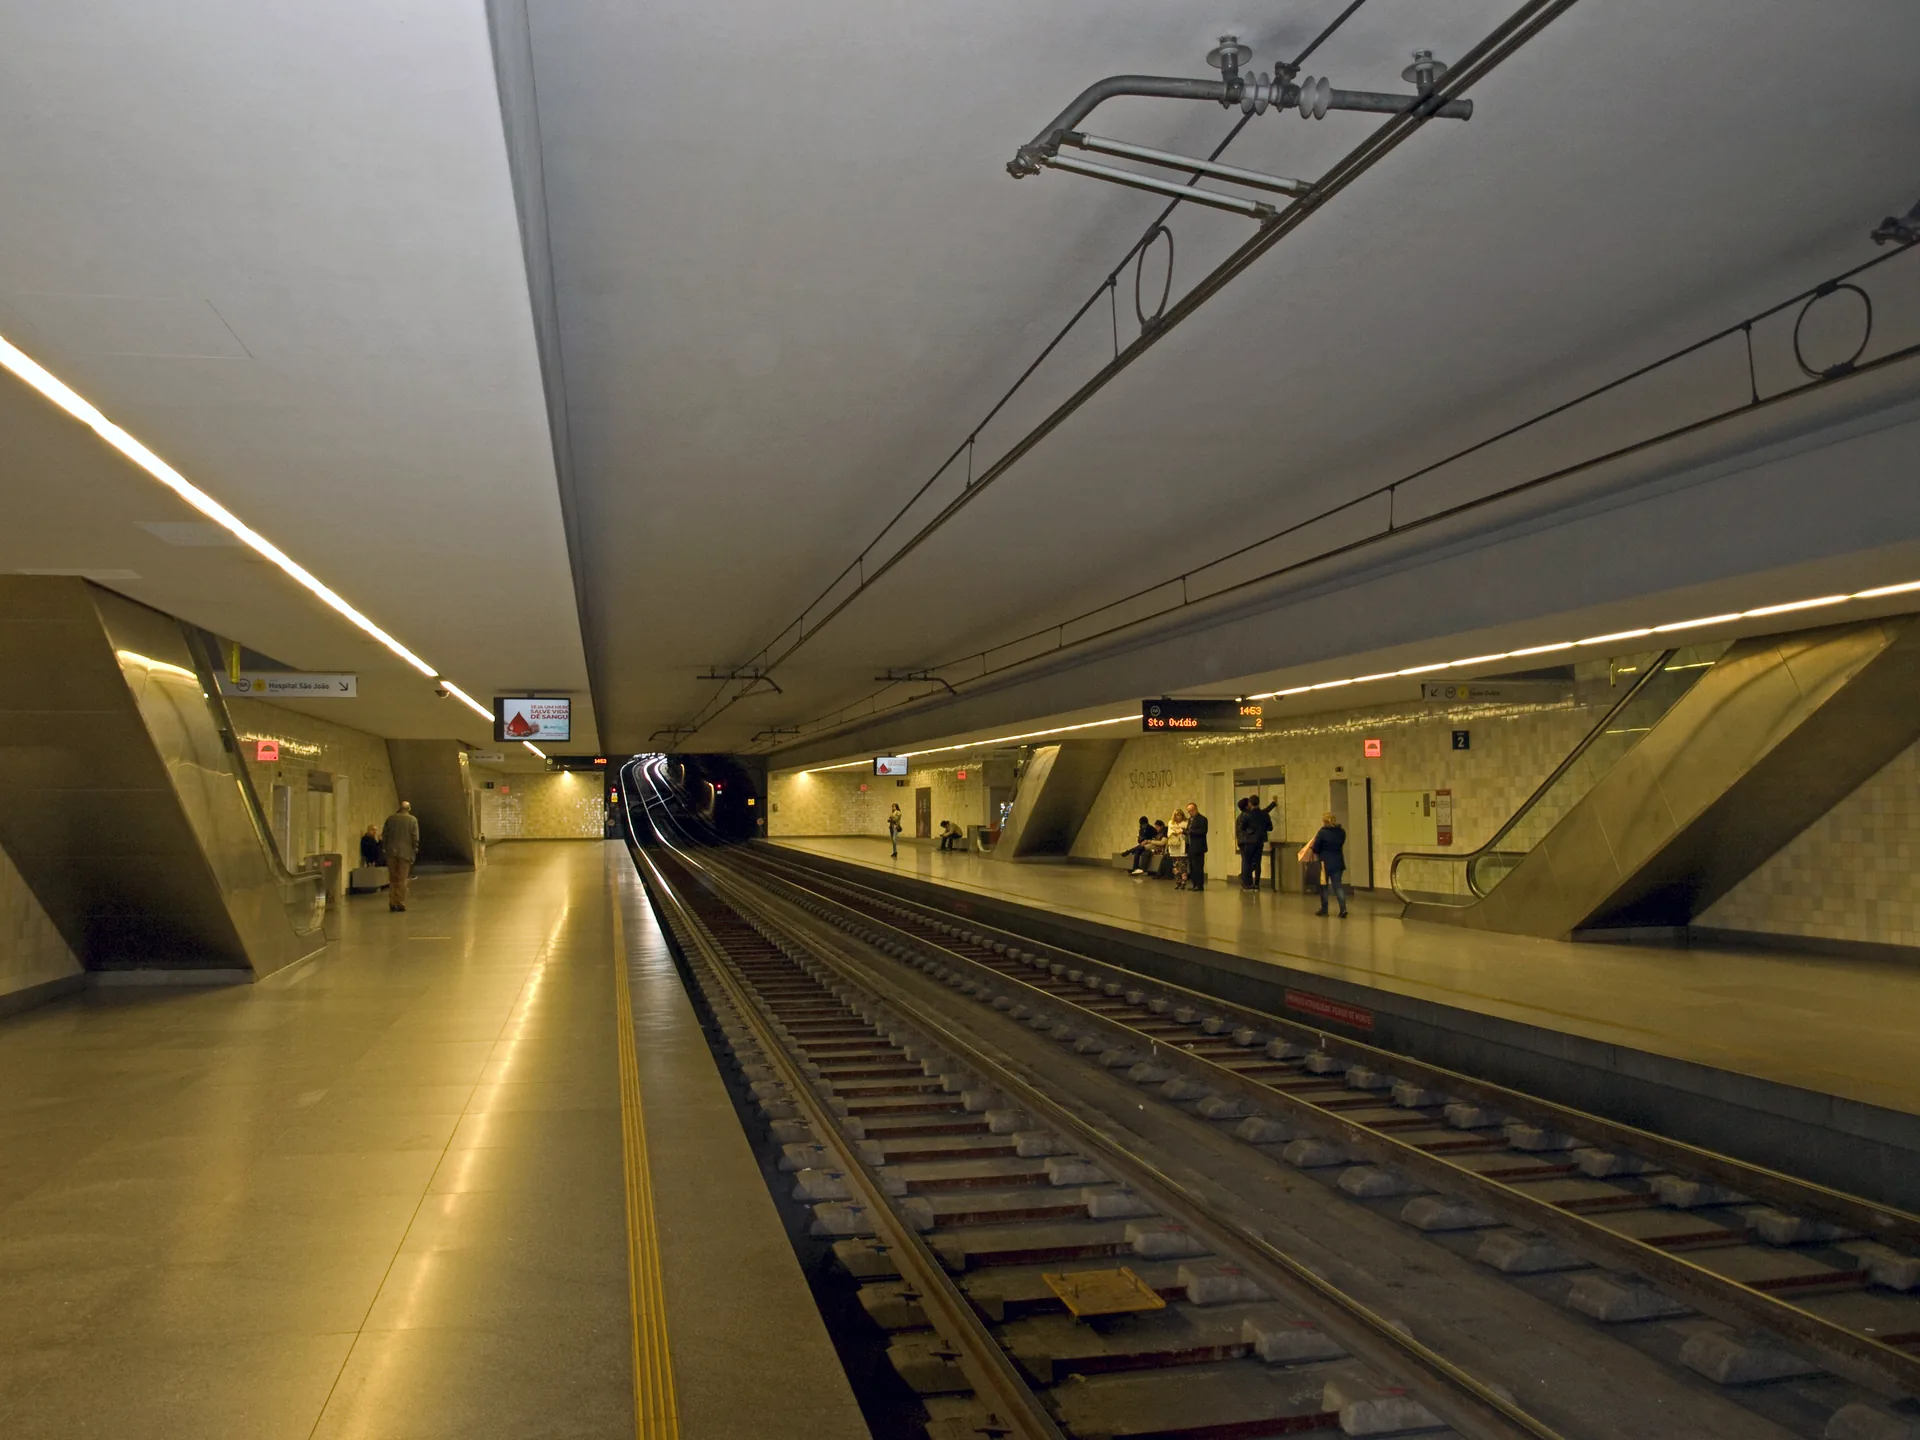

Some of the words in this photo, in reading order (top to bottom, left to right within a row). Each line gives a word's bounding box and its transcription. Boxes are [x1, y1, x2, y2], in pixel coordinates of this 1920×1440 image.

[268, 682, 297, 690] Hospital
[299, 682, 312, 690] São
[1147, 718, 1165, 727] Sto
[1255, 718, 1262, 727] 2
[1457, 736, 1465, 748] 2
[1129, 769, 1145, 789] SÃO
[1147, 769, 1173, 789] BENTO
